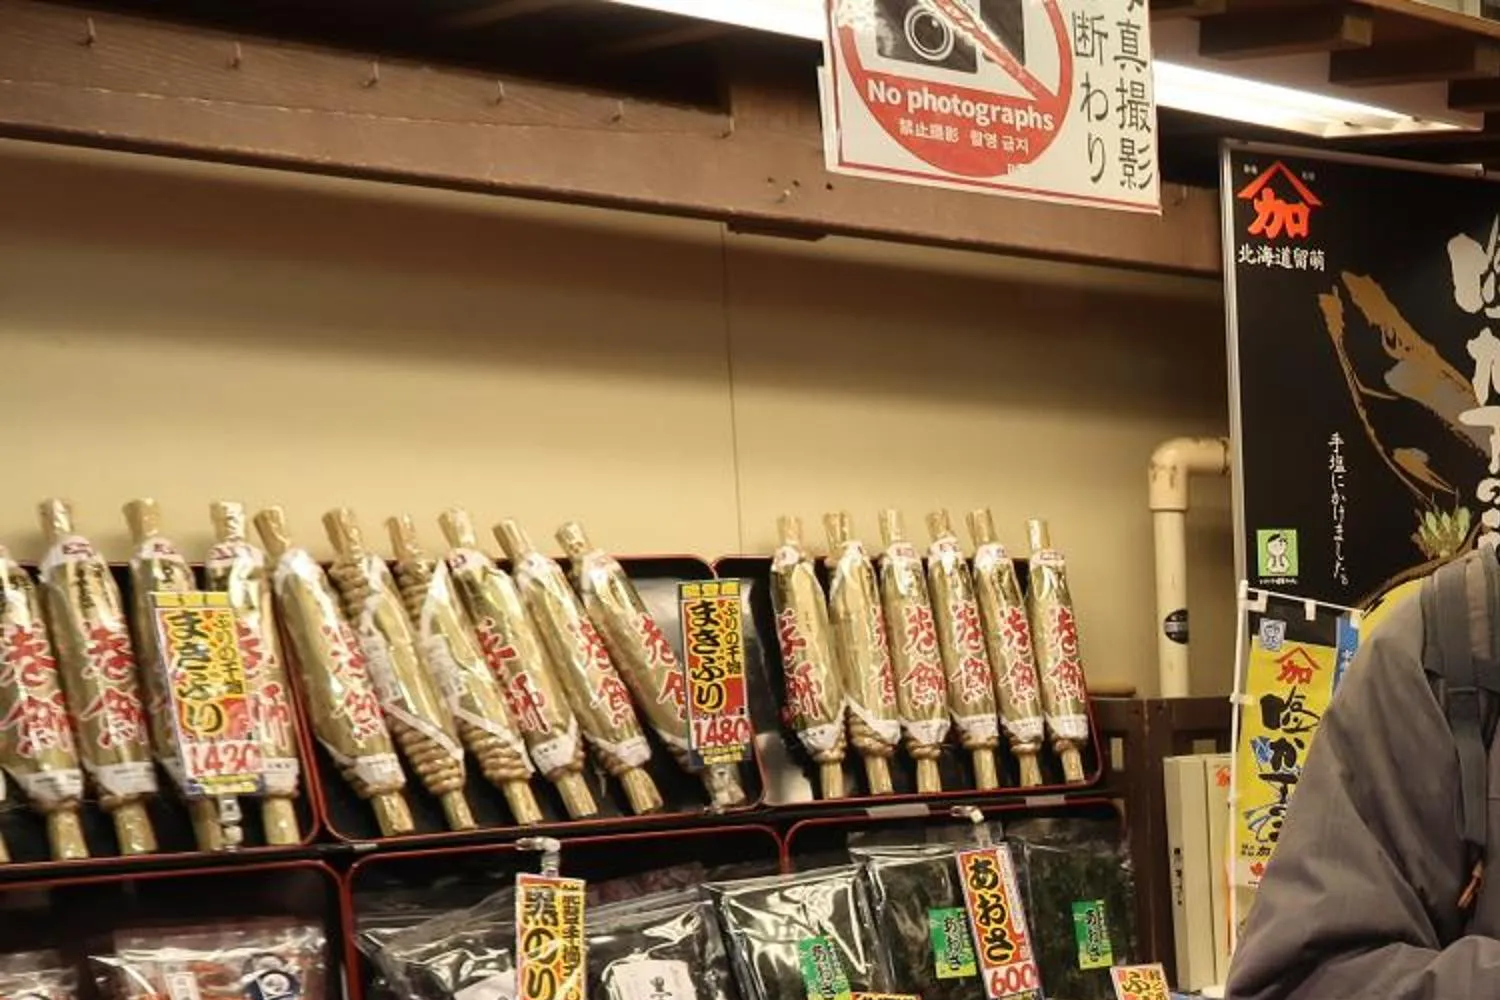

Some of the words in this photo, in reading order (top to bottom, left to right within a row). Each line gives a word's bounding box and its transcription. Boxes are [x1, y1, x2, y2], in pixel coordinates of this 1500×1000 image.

[867, 79, 901, 104] No
[908, 86, 1054, 131] photographs
[1113, 0, 1152, 190] 真撮影
[1238, 243, 1326, 273] 北海道留萌
[691, 601, 725, 709] まきぶり
[969, 857, 1014, 961] あおさ
[990, 963, 1038, 997] 600
